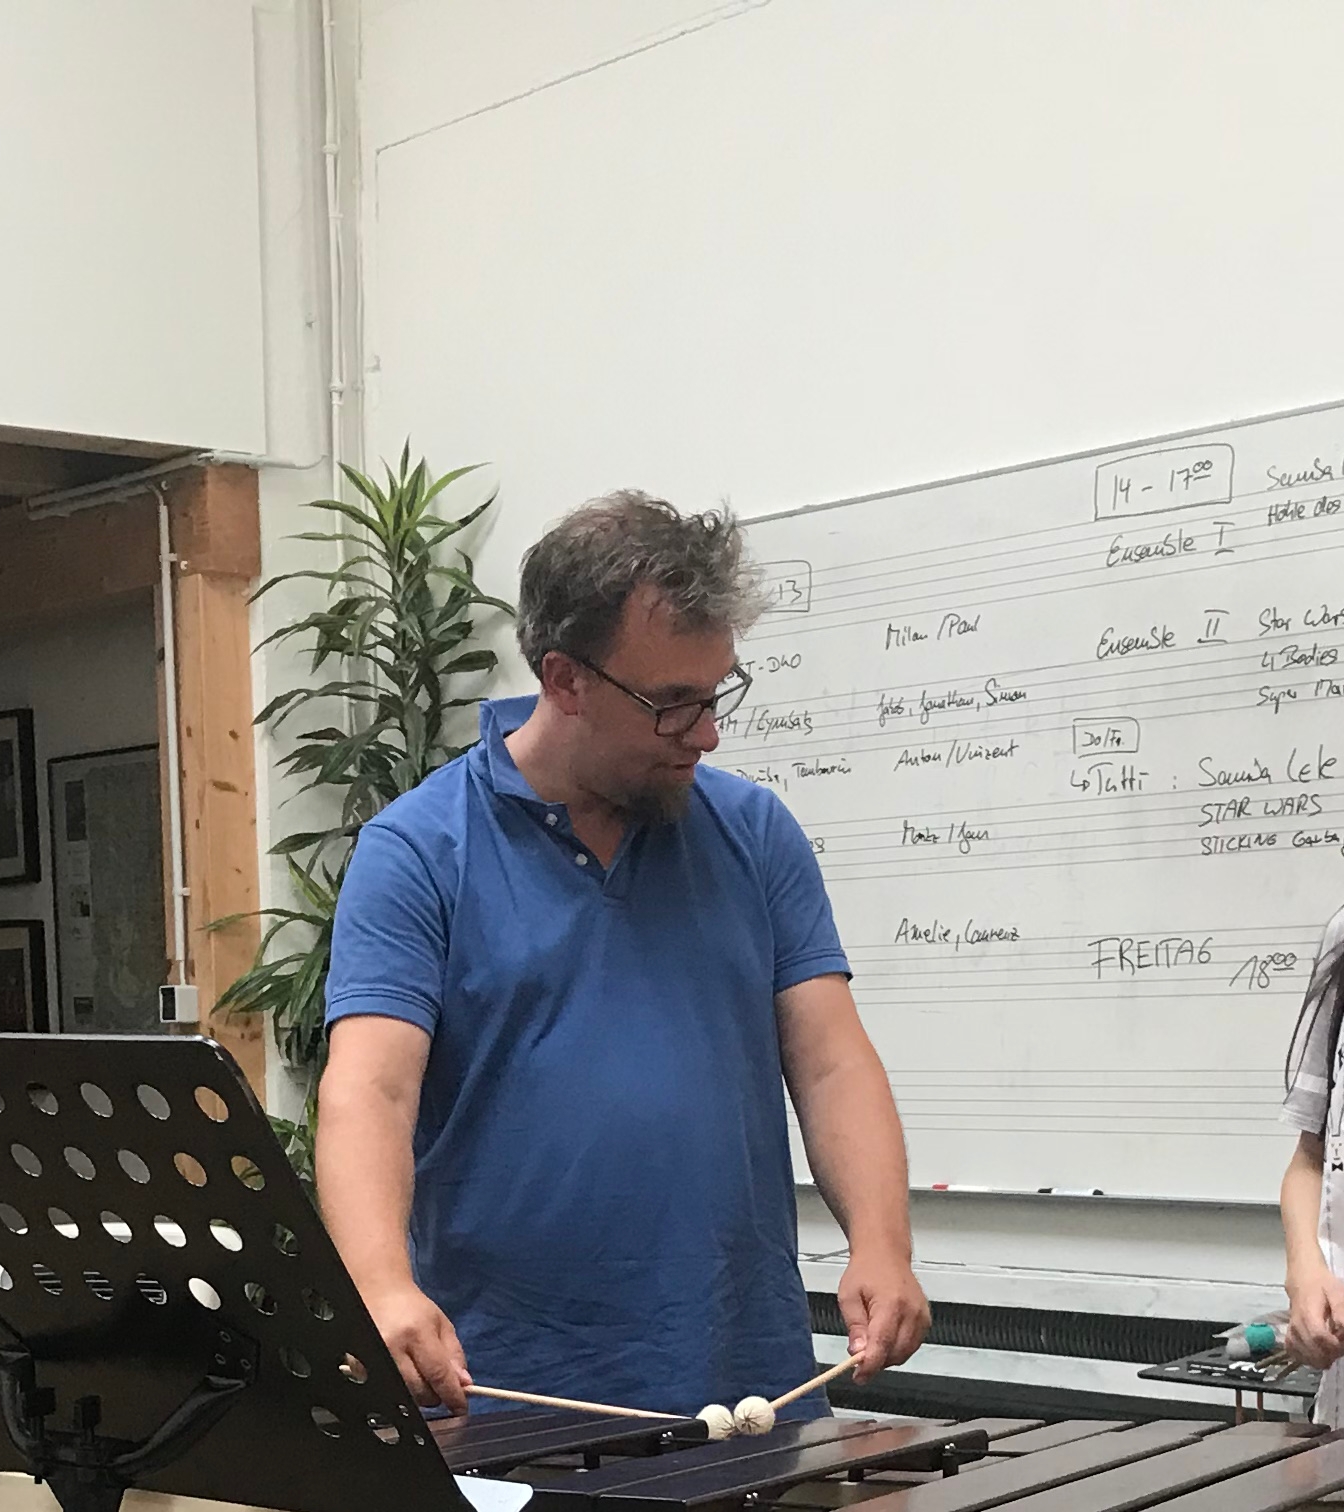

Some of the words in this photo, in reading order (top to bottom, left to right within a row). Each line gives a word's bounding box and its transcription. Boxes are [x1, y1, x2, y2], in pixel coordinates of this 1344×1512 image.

[1112, 474, 1132, 511] 14
[1198, 795, 1253, 828] STAR
[1263, 794, 1323, 818] WARS
[1086, 936, 1214, 980] FREITAG
